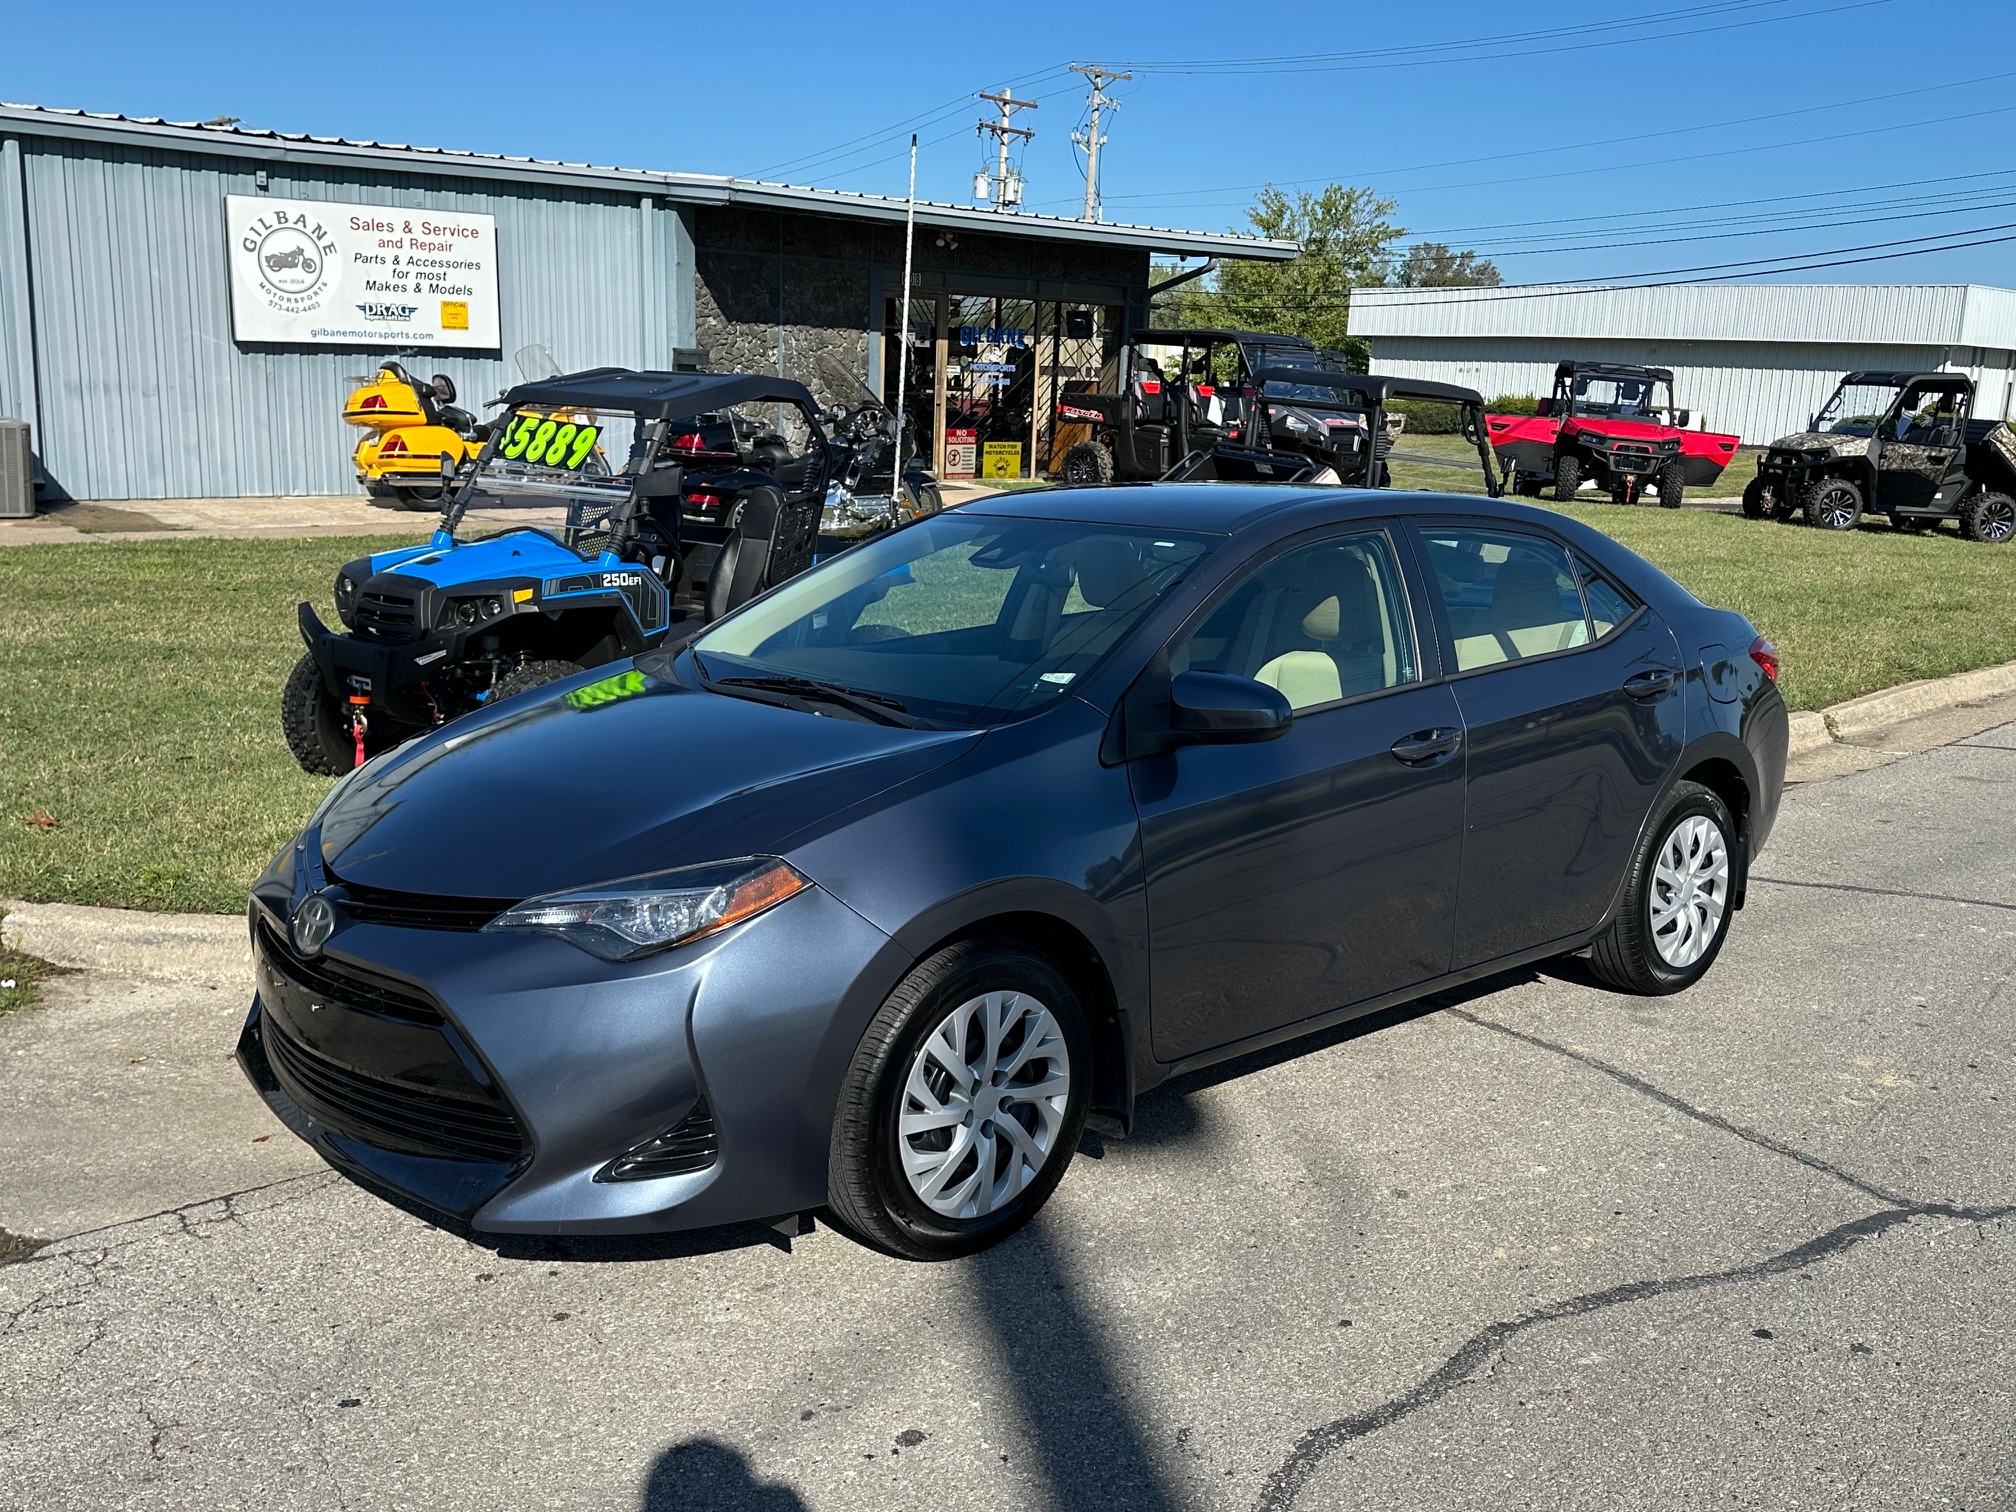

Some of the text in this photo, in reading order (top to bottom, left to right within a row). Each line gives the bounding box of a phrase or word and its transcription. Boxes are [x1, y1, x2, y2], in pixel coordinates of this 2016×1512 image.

[243, 210, 338, 256] GILBANE
[350, 216, 479, 239] Sales & Service
[378, 238, 454, 253] and Repair
[354, 252, 481, 270] Parts & Accessories
[392, 268, 447, 281] for most
[259, 281, 328, 304] MOTORSPORTS
[365, 280, 473, 296] Makes & Models
[268, 299, 321, 314] 573-442-4403
[365, 302, 410, 316] DRAG
[310, 328, 434, 341] gilbanemotorsports.com
[960, 326, 1026, 349] GILBANE
[1065, 406, 1102, 419] RANGER
[499, 416, 597, 469] $5889
